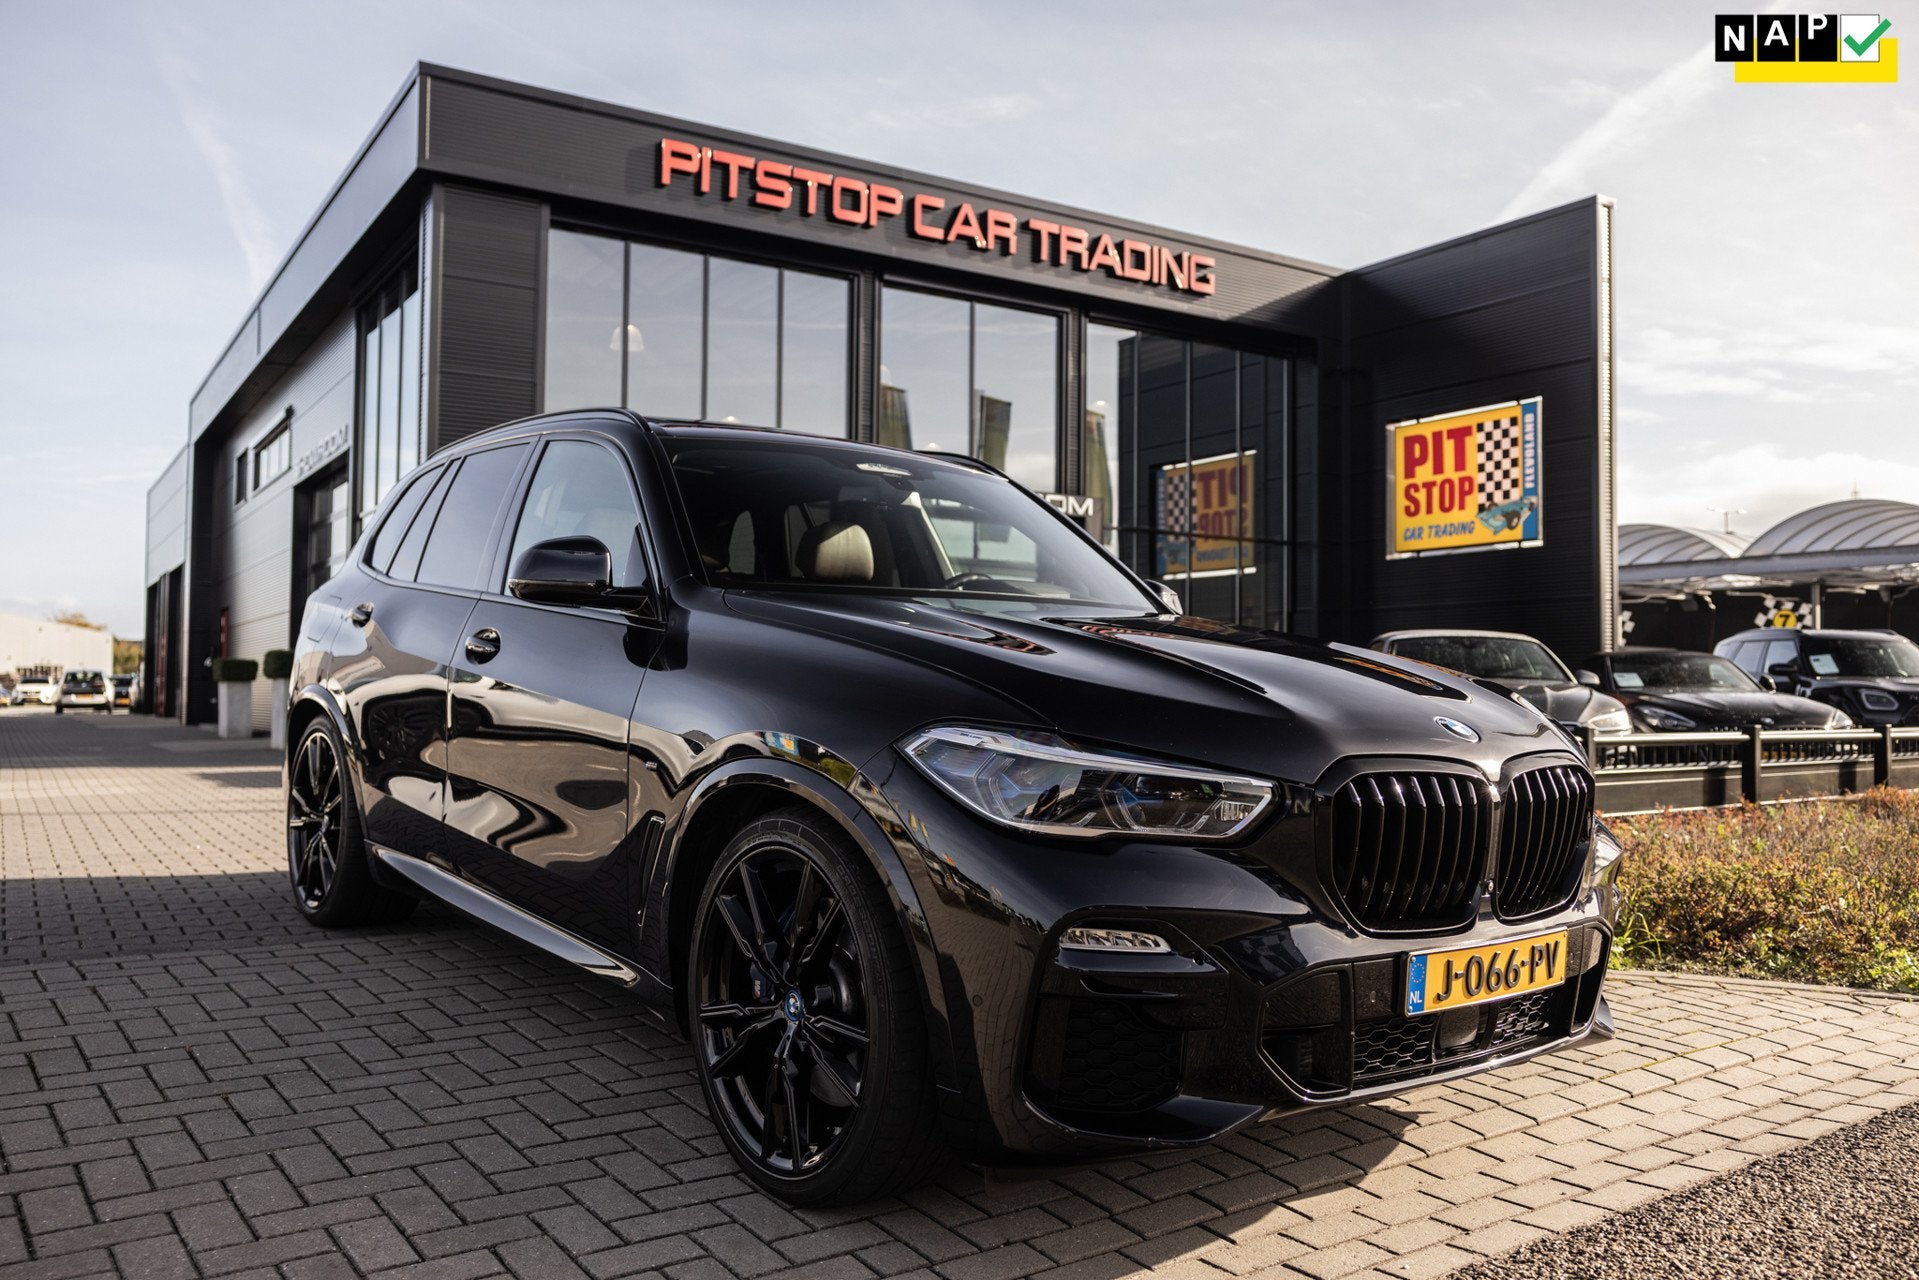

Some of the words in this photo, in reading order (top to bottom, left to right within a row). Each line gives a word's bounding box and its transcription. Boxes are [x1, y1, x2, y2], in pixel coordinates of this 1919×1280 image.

[661, 137, 904, 227] PITSTOP
[913, 192, 1018, 255] CAR
[1028, 217, 1216, 295] TRADING
[1403, 425, 1473, 480] PIT
[1038, 493, 1094, 516] OM
[1404, 475, 1475, 518] STOP
[1403, 526, 1424, 542] CAR
[1428, 520, 1476, 538] TRADING
[1779, 613, 1791, 627] 7
[1436, 940, 1561, 1002] J-066-PV
[1409, 991, 1423, 1004] NL
